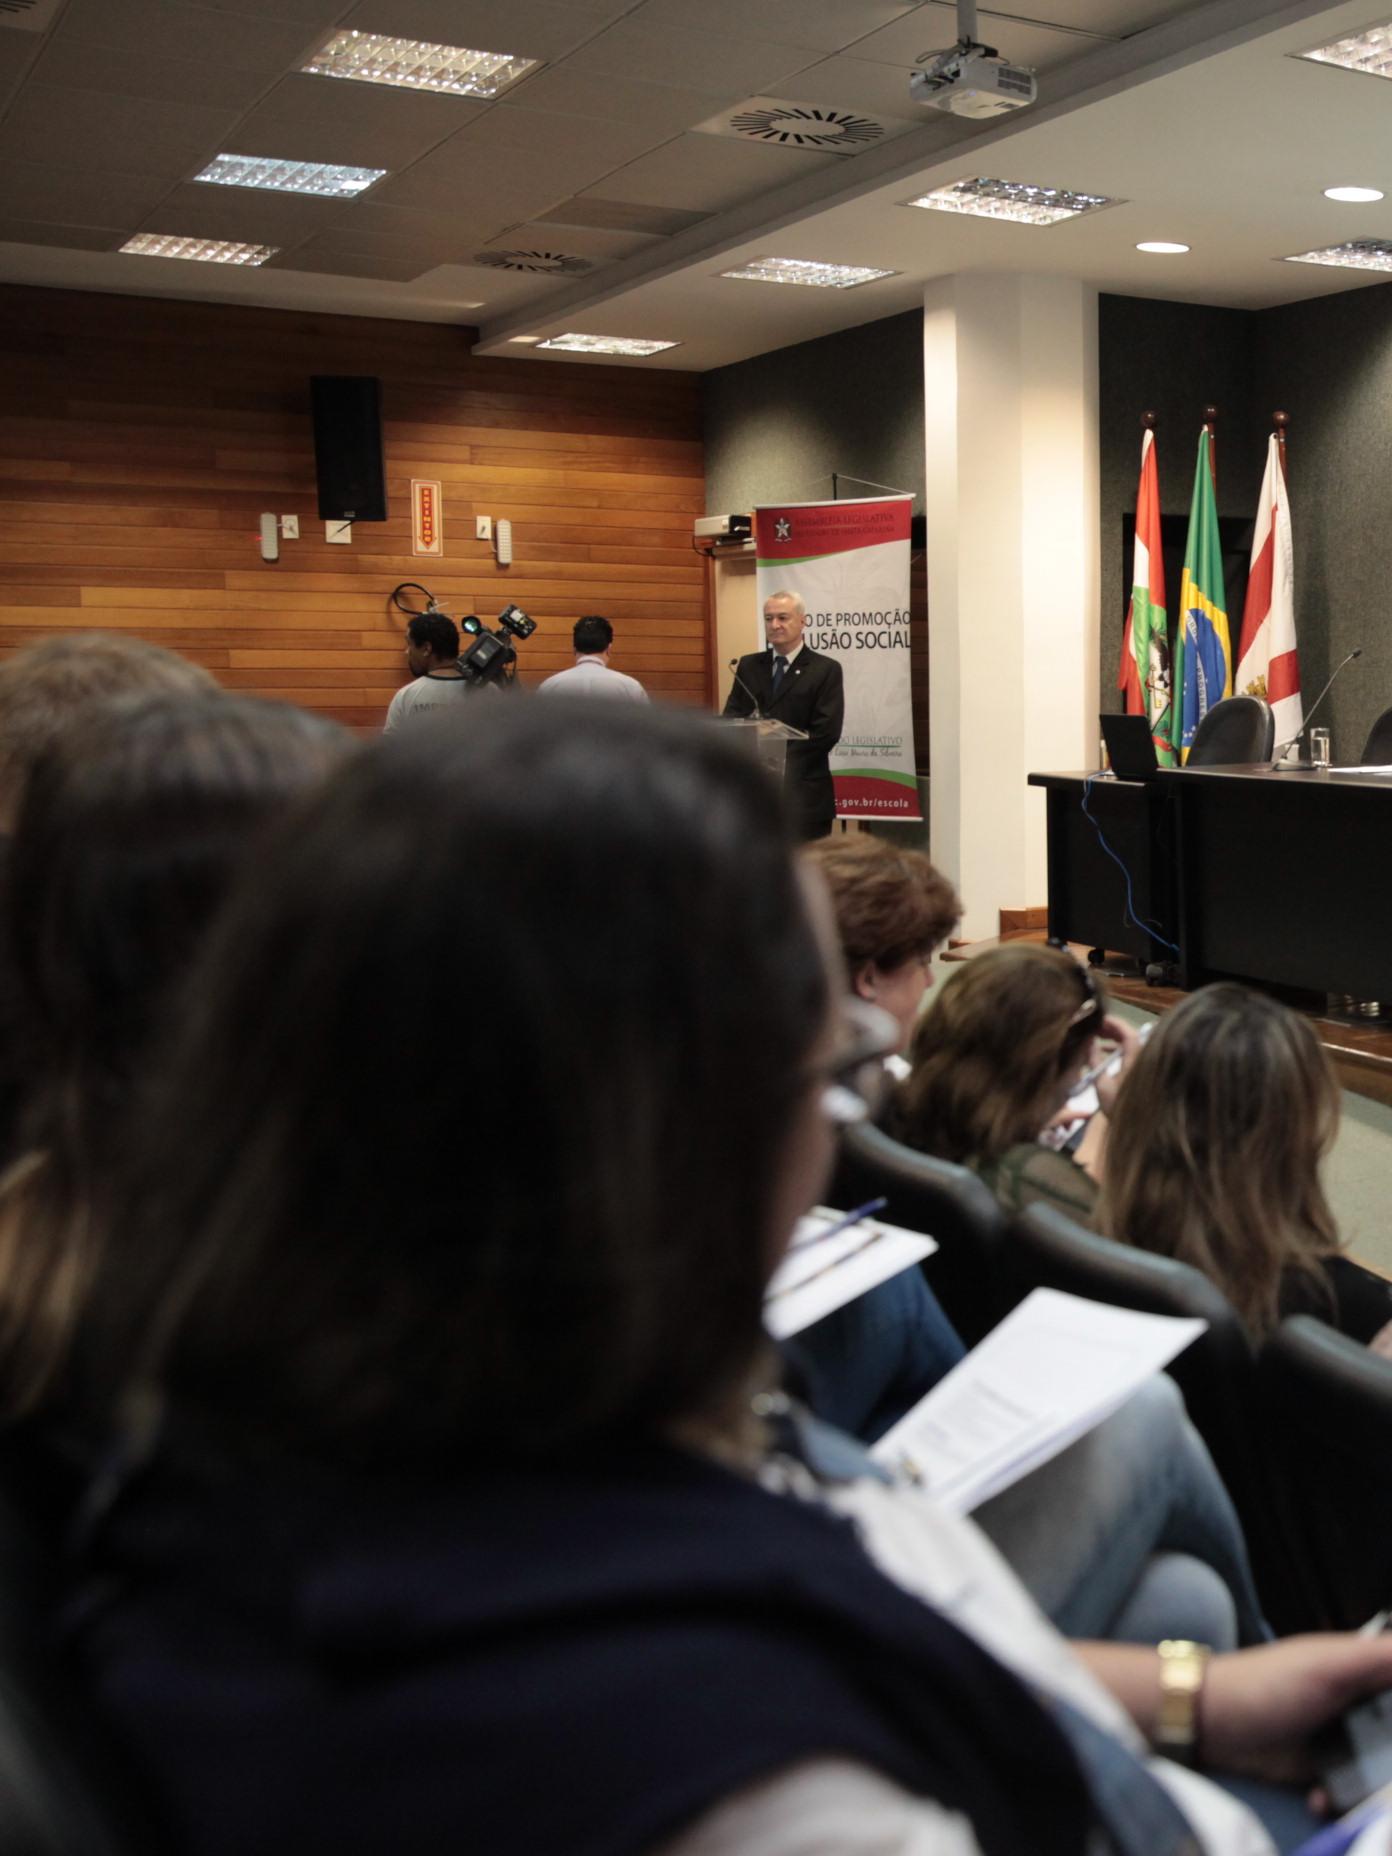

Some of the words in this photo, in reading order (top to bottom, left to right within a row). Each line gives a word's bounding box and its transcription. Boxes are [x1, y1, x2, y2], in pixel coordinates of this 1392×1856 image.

[816, 613, 832, 627] DE
[836, 608, 910, 629] PROMOÇÃO
[802, 629, 852, 650] USÃO
[855, 631, 910, 650] SOCIAL
[852, 736, 903, 745] LEGISLATIVO
